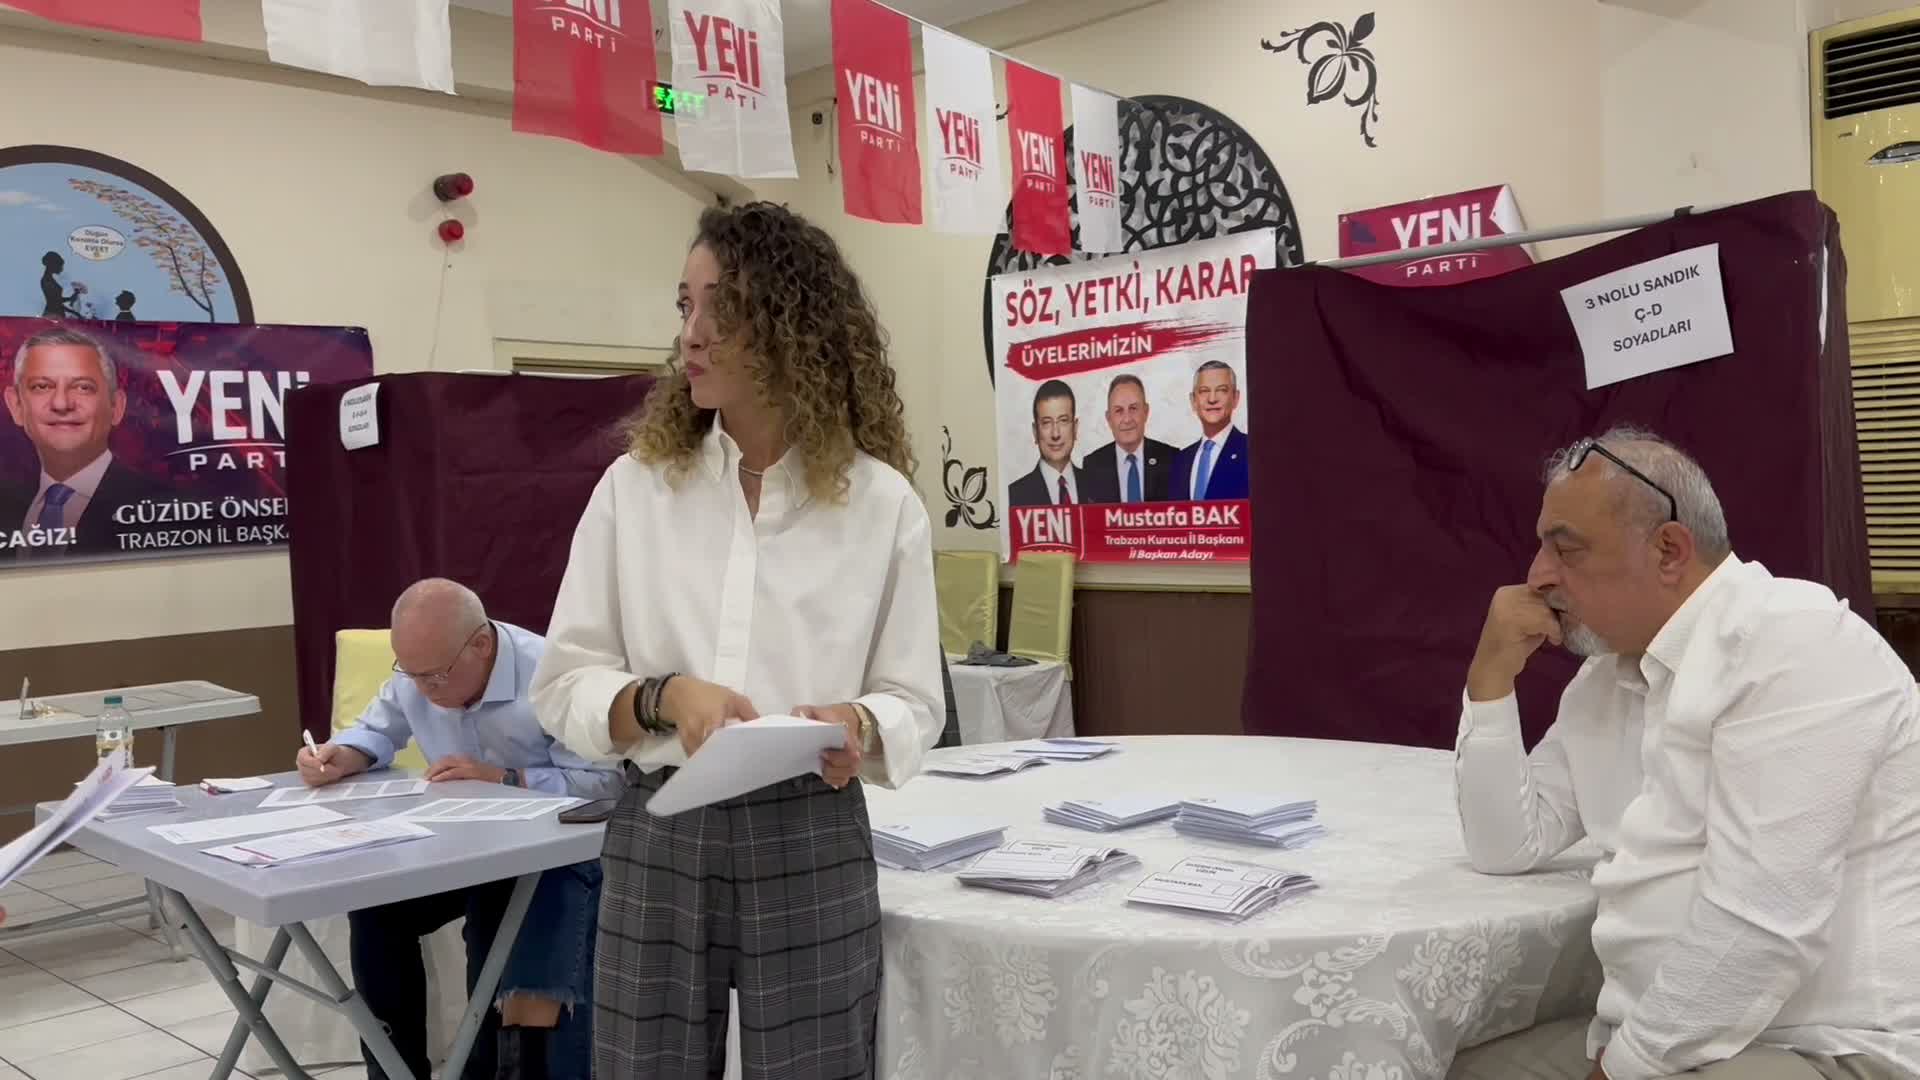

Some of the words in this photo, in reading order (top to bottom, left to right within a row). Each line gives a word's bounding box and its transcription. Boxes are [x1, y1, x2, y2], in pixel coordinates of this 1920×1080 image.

[1006, 279, 1060, 327] SÖZ,
[1066, 261, 1149, 318] YETKİ,
[1585, 298, 1596, 310] 3
[1598, 283, 1640, 307] NOLU
[1643, 264, 1700, 293] SANDIK
[1634, 303, 1663, 323] Ç-D
[1021, 331, 1153, 367] ÜYELERİMİZİN
[1613, 319, 1692, 352] SOYADLARI
[116, 499, 214, 524] GÜZİDE
[220, 496, 288, 518] ÖNSE
[1104, 506, 1188, 527] Mustafa
[1191, 504, 1240, 525] BAK
[117, 529, 212, 549] TRABZON
[217, 523, 232, 544] İL
[236, 524, 289, 545] BAŞK
[1104, 534, 1146, 545] Trabzon
[1147, 535, 1187, 545] Kurucu
[1197, 533, 1244, 546] Başkanı
[1137, 549, 1178, 560] Başkan
[1178, 549, 1214, 560] Adayı
